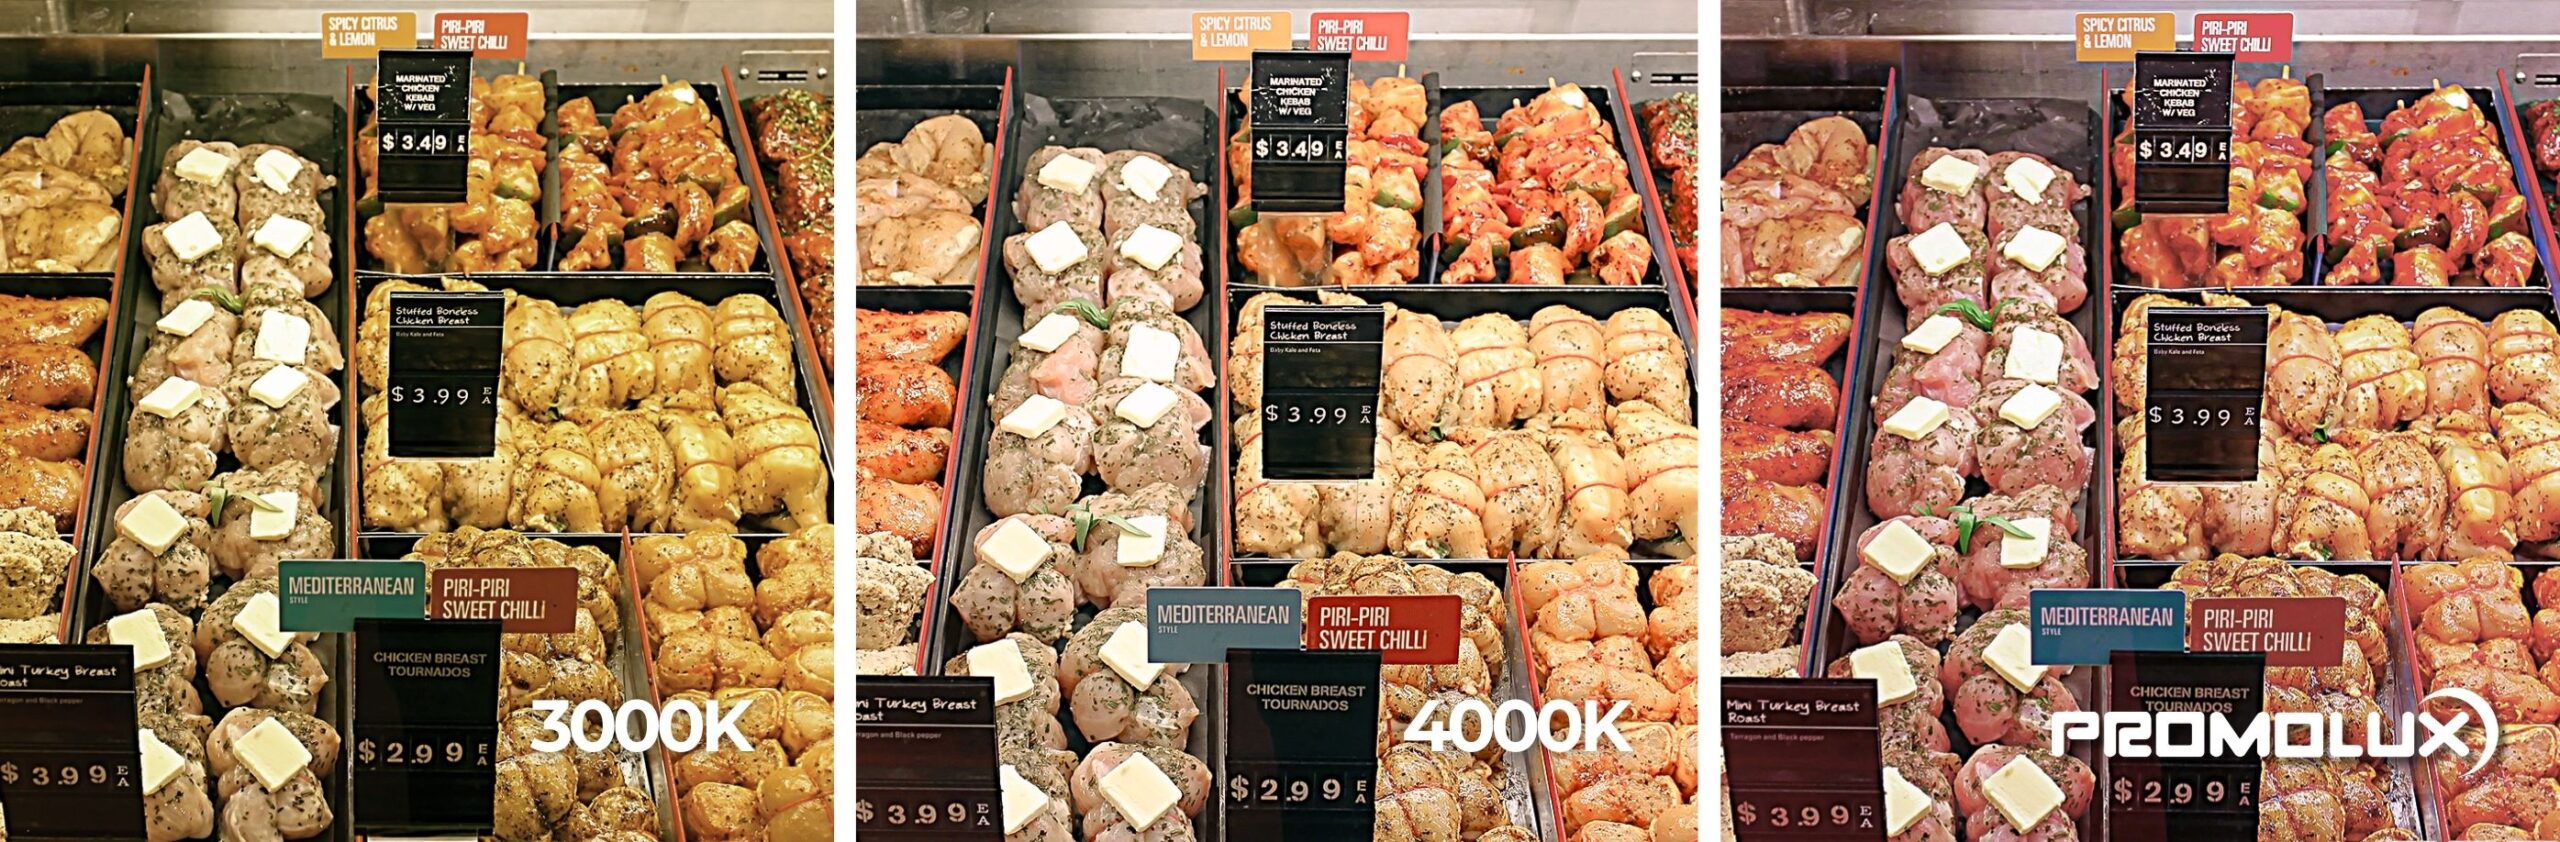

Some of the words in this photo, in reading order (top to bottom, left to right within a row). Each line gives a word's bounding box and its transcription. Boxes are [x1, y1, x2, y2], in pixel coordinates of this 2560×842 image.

[329, 17, 359, 31] SPICY
[361, 17, 398, 31] CITRUS
[442, 20, 485, 34] PIRI-PIRI
[1200, 16, 1232, 31] SPICY
[1233, 16, 1272, 31] CITRUS
[1318, 19, 1364, 34] PIRI-PIRI
[2083, 17, 2114, 32] SPICY
[2117, 17, 2155, 32] CITRUS
[2201, 21, 2247, 35] PIRI-PIRI
[329, 33, 337, 46] &
[339, 33, 376, 46] LEMON
[441, 35, 475, 50] SWEET
[478, 35, 508, 50] CHILLI
[1200, 33, 1208, 48] &
[1211, 33, 1248, 47] LEMON
[1317, 36, 1354, 51] SWEET
[1356, 36, 1387, 51] CHILLI
[2083, 34, 2091, 49] &
[2094, 34, 2132, 49] LEMON
[2201, 37, 2237, 52] SWEET
[2240, 37, 2271, 52] CHILLI
[396, 75, 446, 83] MARINATED
[1270, 77, 1322, 86] MARINATED
[2153, 79, 2206, 88] MARINATED
[406, 94, 434, 102] KEBAB
[1275, 87, 1316, 96] CHICKEN
[2159, 89, 2200, 97] CHICKEN
[404, 103, 416, 111] W/
[417, 103, 435, 111] VEG
[1280, 98, 1311, 106] KEBAB
[2164, 99, 2194, 107] KEBAB
[1278, 107, 1291, 116] W/
[1293, 107, 1312, 116] VEG
[2162, 108, 2176, 117] W/
[2177, 108, 2195, 117] VEG
[396, 306, 432, 315] Stuffed
[436, 306, 479, 315] Boneless
[396, 316, 434, 325] Chicken
[438, 316, 470, 325] Breast
[1270, 321, 1309, 330] Stuffed
[1312, 321, 1357, 330] Boneless
[2153, 323, 2192, 332] Stuffed
[2196, 323, 2241, 332] Boneless
[1270, 331, 1310, 340] Chicken
[1314, 331, 1348, 340] Breast
[2153, 333, 2193, 342] Chicken
[2198, 333, 2231, 342] Breast
[289, 577, 414, 595] MEDITERRANEAN
[443, 578, 510, 597] PIRI-PIRI
[442, 600, 494, 620] SWEET
[500, 600, 546, 619] CHILLI
[1157, 605, 1289, 625] MEDITERRANEAN
[1320, 606, 1389, 627] PIRI-PIRI
[2041, 607, 2173, 627] MEDITERRANEAN
[2204, 608, 2273, 629] PIRI-PIRI
[1158, 625, 1178, 634] STYLE
[2041, 628, 2061, 636] STYLE
[1319, 630, 1375, 650] SWEET
[1379, 630, 1427, 650] CHILLI
[2203, 632, 2258, 652] SWEET
[2263, 632, 2311, 652] CHILLI
[373, 652, 432, 664] CHICKEN
[435, 653, 487, 665] BREAST
[20, 664, 70, 680] Turkey
[75, 666, 117, 676] Breast
[388, 666, 471, 678] TOURNADOS
[0, 678, 28, 687] oast
[1246, 684, 1308, 696] CHICKEN
[1311, 685, 1366, 697] BREAST
[2130, 686, 2192, 698] CHICKEN
[2194, 687, 2249, 699] BREAST
[874, 697, 926, 713] Turkey
[932, 698, 977, 710] Breast
[1261, 699, 1349, 712] TOURNADOS
[1726, 700, 1752, 711] Mini
[1758, 700, 1809, 715] Turkey
[1815, 700, 1860, 712] Breast
[2145, 701, 2233, 713] TOURNADOS
[856, 711, 883, 721] oast
[1728, 712, 1767, 723] Roast
